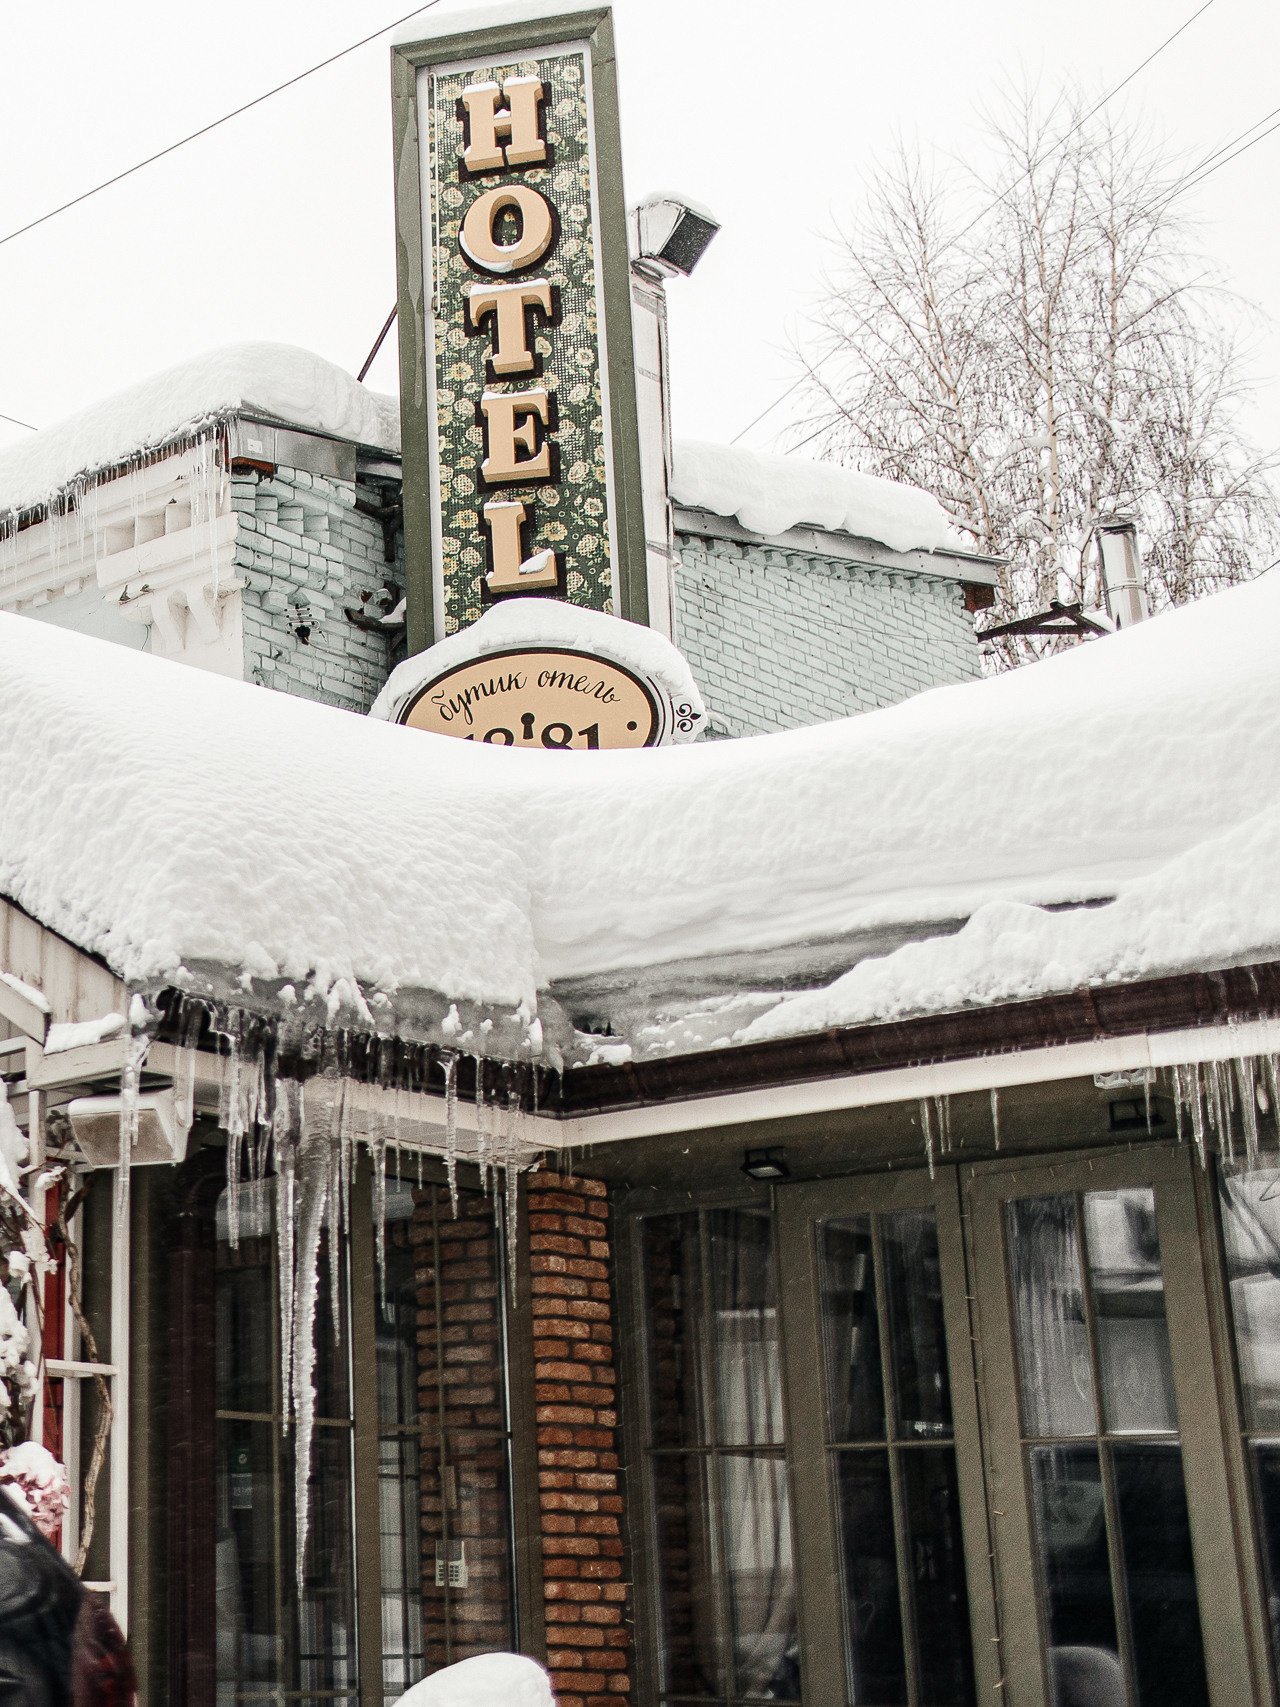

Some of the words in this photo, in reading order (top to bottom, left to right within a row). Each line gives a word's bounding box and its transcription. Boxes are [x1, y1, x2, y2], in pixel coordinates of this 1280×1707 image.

[459, 76, 560, 596] HOTEL
[431, 671, 527, 726] бутик
[538, 670, 621, 704] отель
